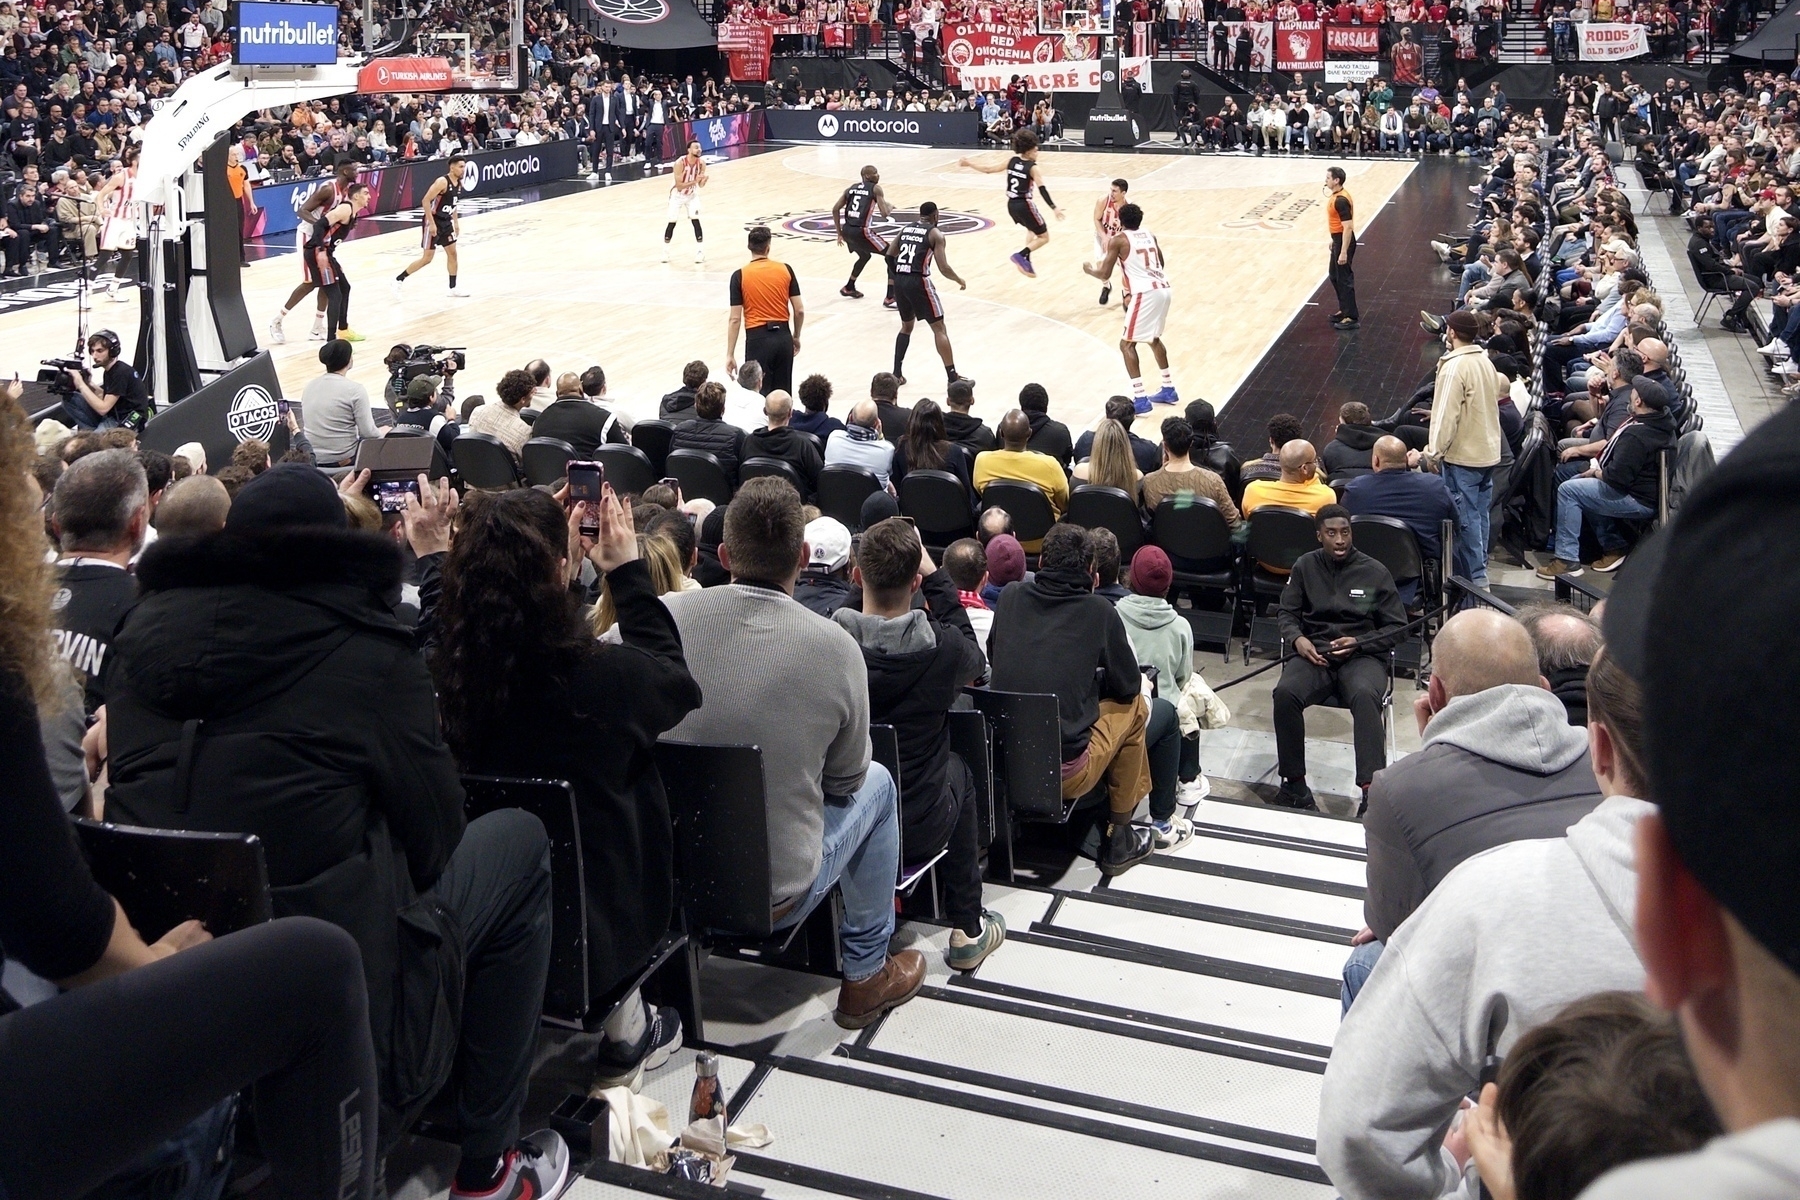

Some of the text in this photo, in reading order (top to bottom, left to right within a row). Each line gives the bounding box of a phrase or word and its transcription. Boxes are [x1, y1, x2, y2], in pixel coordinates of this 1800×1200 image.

[990, 36, 1014, 47] RED
[1327, 30, 1378, 48] FARSALA
[1585, 30, 1629, 42] RODOS
[975, 45, 1031, 60] OMOGENIA
[1587, 47, 1604, 55] OLD
[1277, 60, 1324, 70] ΟΛΥΜΠΙΑΚΟΣ
[391, 72, 447, 80] TURKISH AIRLINES
[1027, 68, 1079, 90] ACRÉ
[178, 112, 210, 151] SPALDING
[844, 118, 920, 134] motorola
[483, 155, 540, 181] motorola
[1010, 178, 1019, 193] 2
[851, 196, 861, 211] 5
[897, 243, 916, 264] 24
[1136, 247, 1160, 269] 77
[230, 405, 276, 427] O'TACOS
